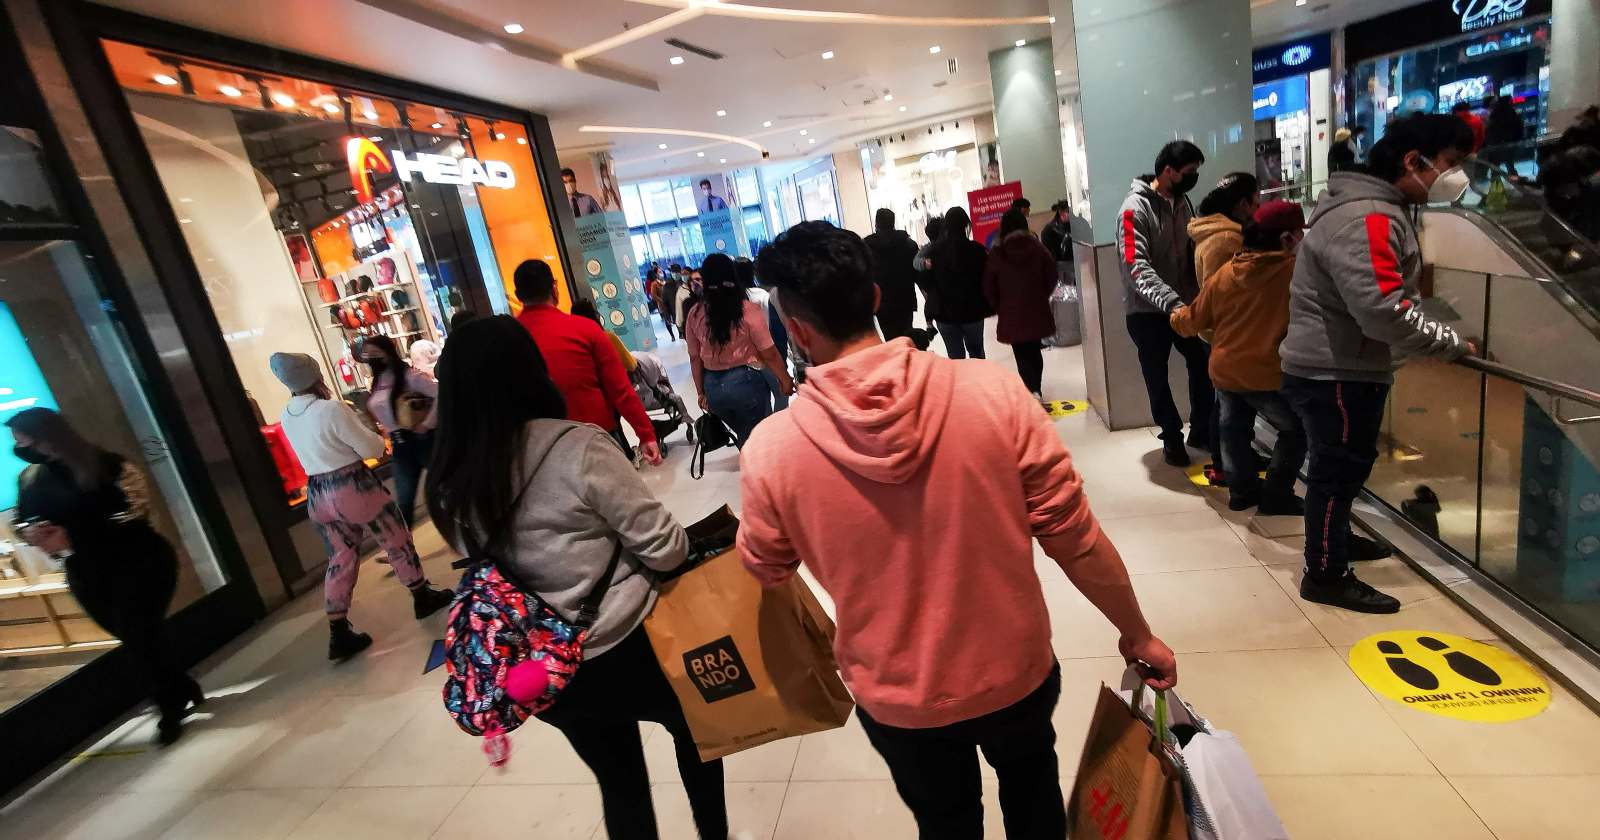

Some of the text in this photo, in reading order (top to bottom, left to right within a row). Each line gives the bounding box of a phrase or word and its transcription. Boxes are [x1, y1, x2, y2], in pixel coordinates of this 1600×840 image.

[1497, 9, 1523, 23] Store
[391, 150, 515, 189] HEAD
[691, 648, 734, 675] BRA
[698, 664, 740, 688] NDO
[1402, 693, 1450, 704] METRO
[1480, 687, 1545, 698] MINIMO
